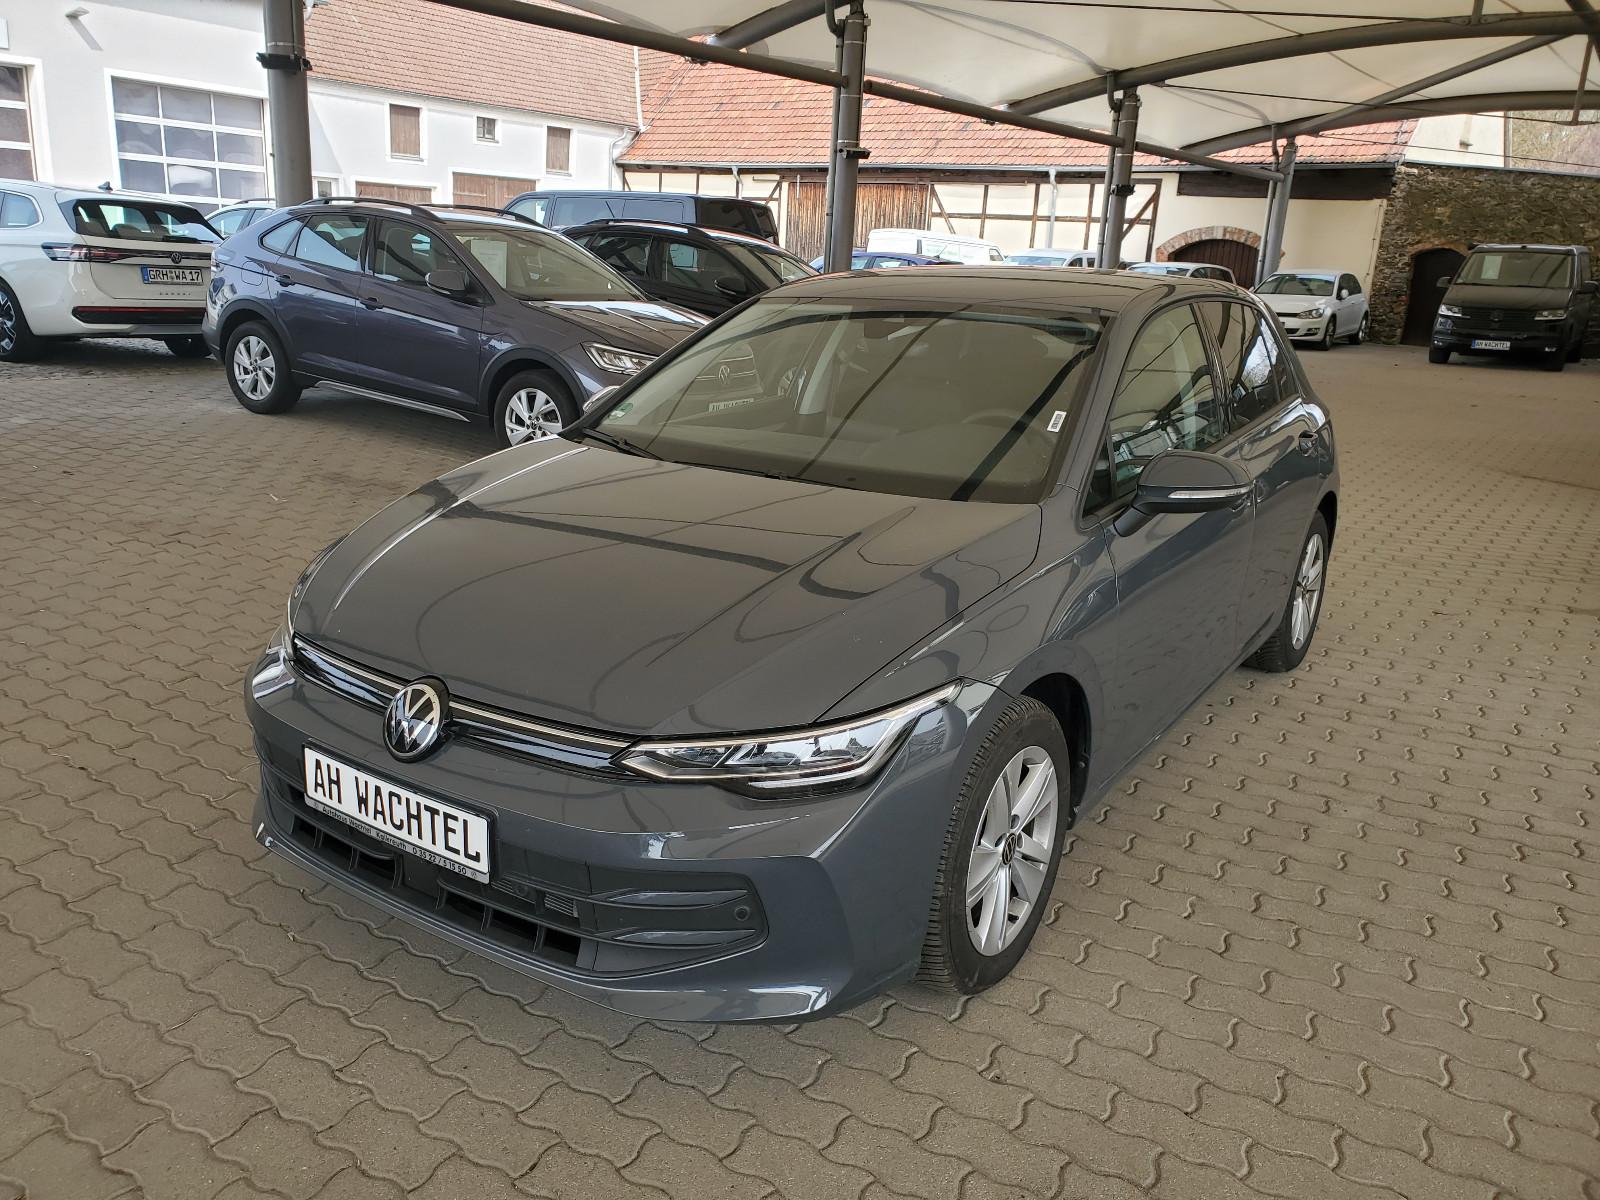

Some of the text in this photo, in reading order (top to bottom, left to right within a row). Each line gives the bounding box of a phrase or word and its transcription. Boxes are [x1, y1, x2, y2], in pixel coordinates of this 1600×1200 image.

[149, 269, 200, 282] GRH WA 17
[314, 758, 481, 863] AH WACHTEL
[322, 805, 348, 824] Autohaus
[348, 818, 372, 835] Wachtel
[419, 849, 427, 859] 35
[428, 853, 437, 863] 22
[449, 861, 457, 871] 15
[457, 865, 467, 875] 50
